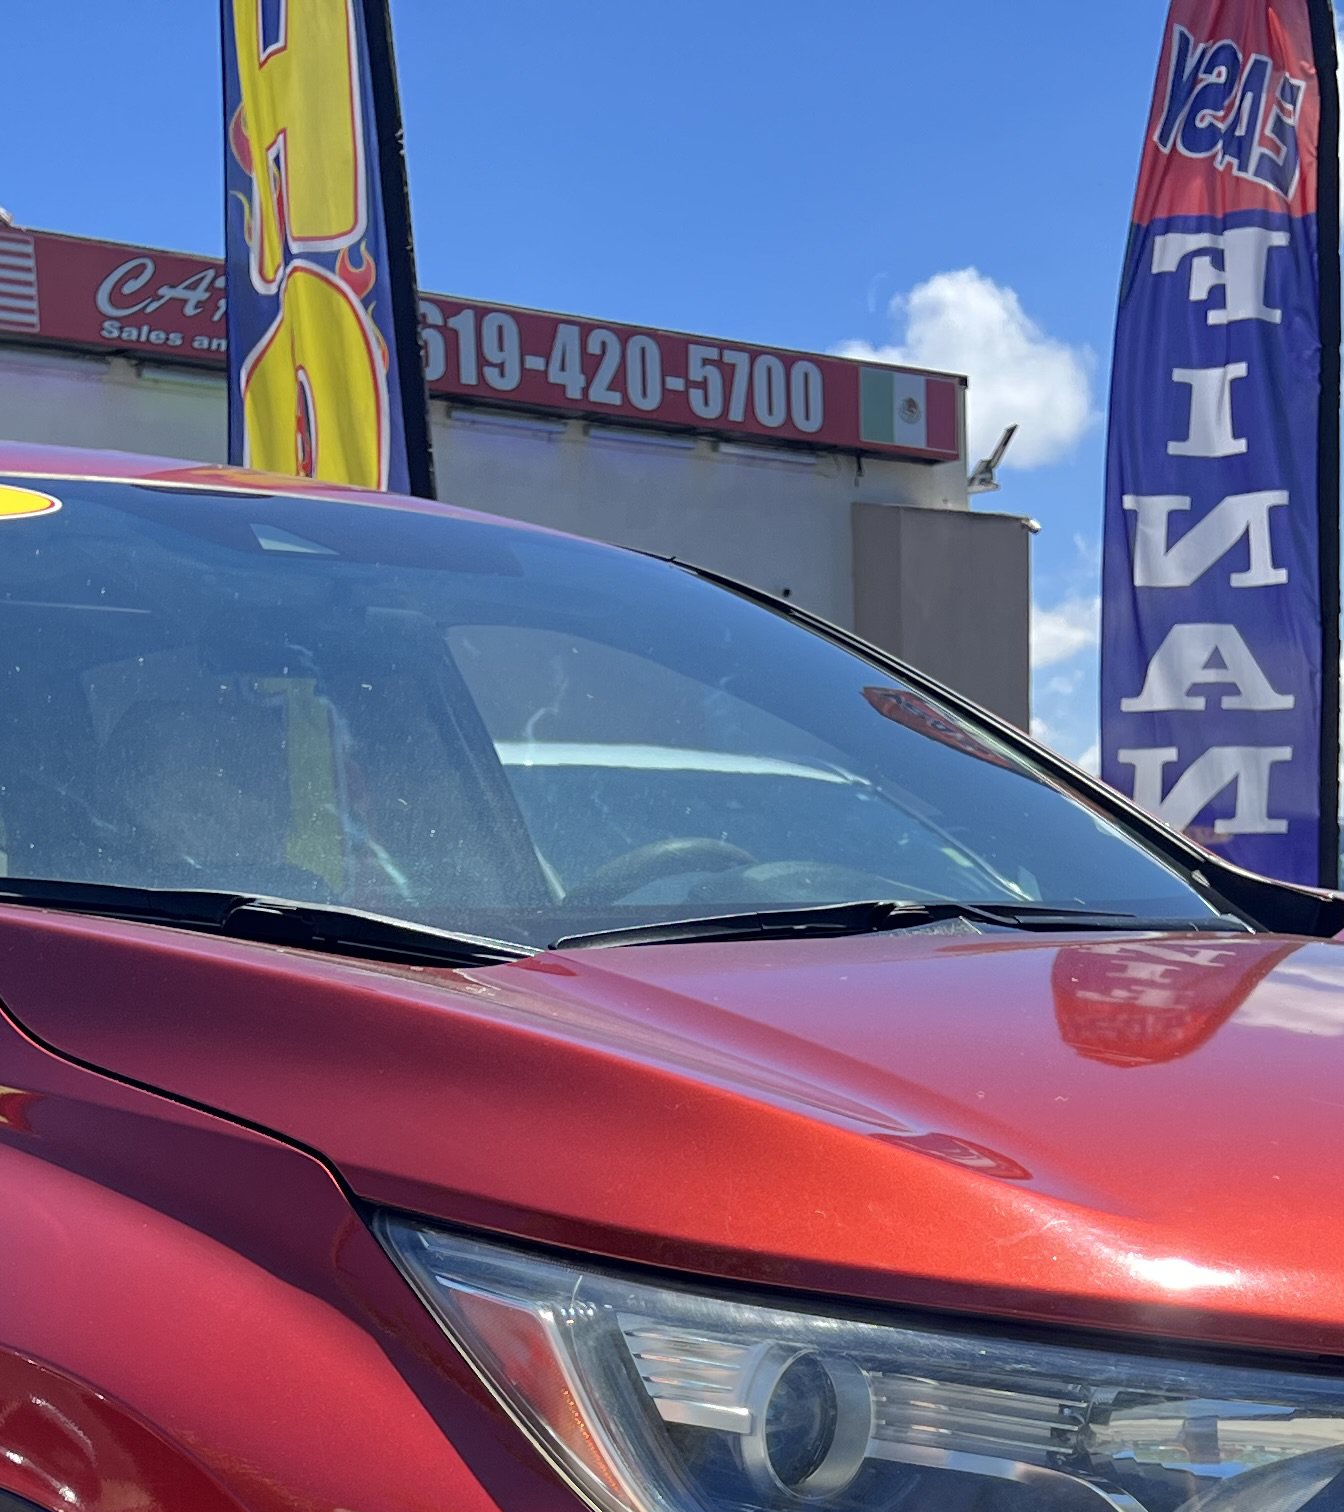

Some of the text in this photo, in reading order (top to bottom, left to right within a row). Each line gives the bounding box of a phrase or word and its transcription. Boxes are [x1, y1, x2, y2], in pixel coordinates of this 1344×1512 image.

[96, 257, 226, 322] CA
[100, 320, 184, 347] Sales
[419, 299, 824, 434] 619-420-5700
